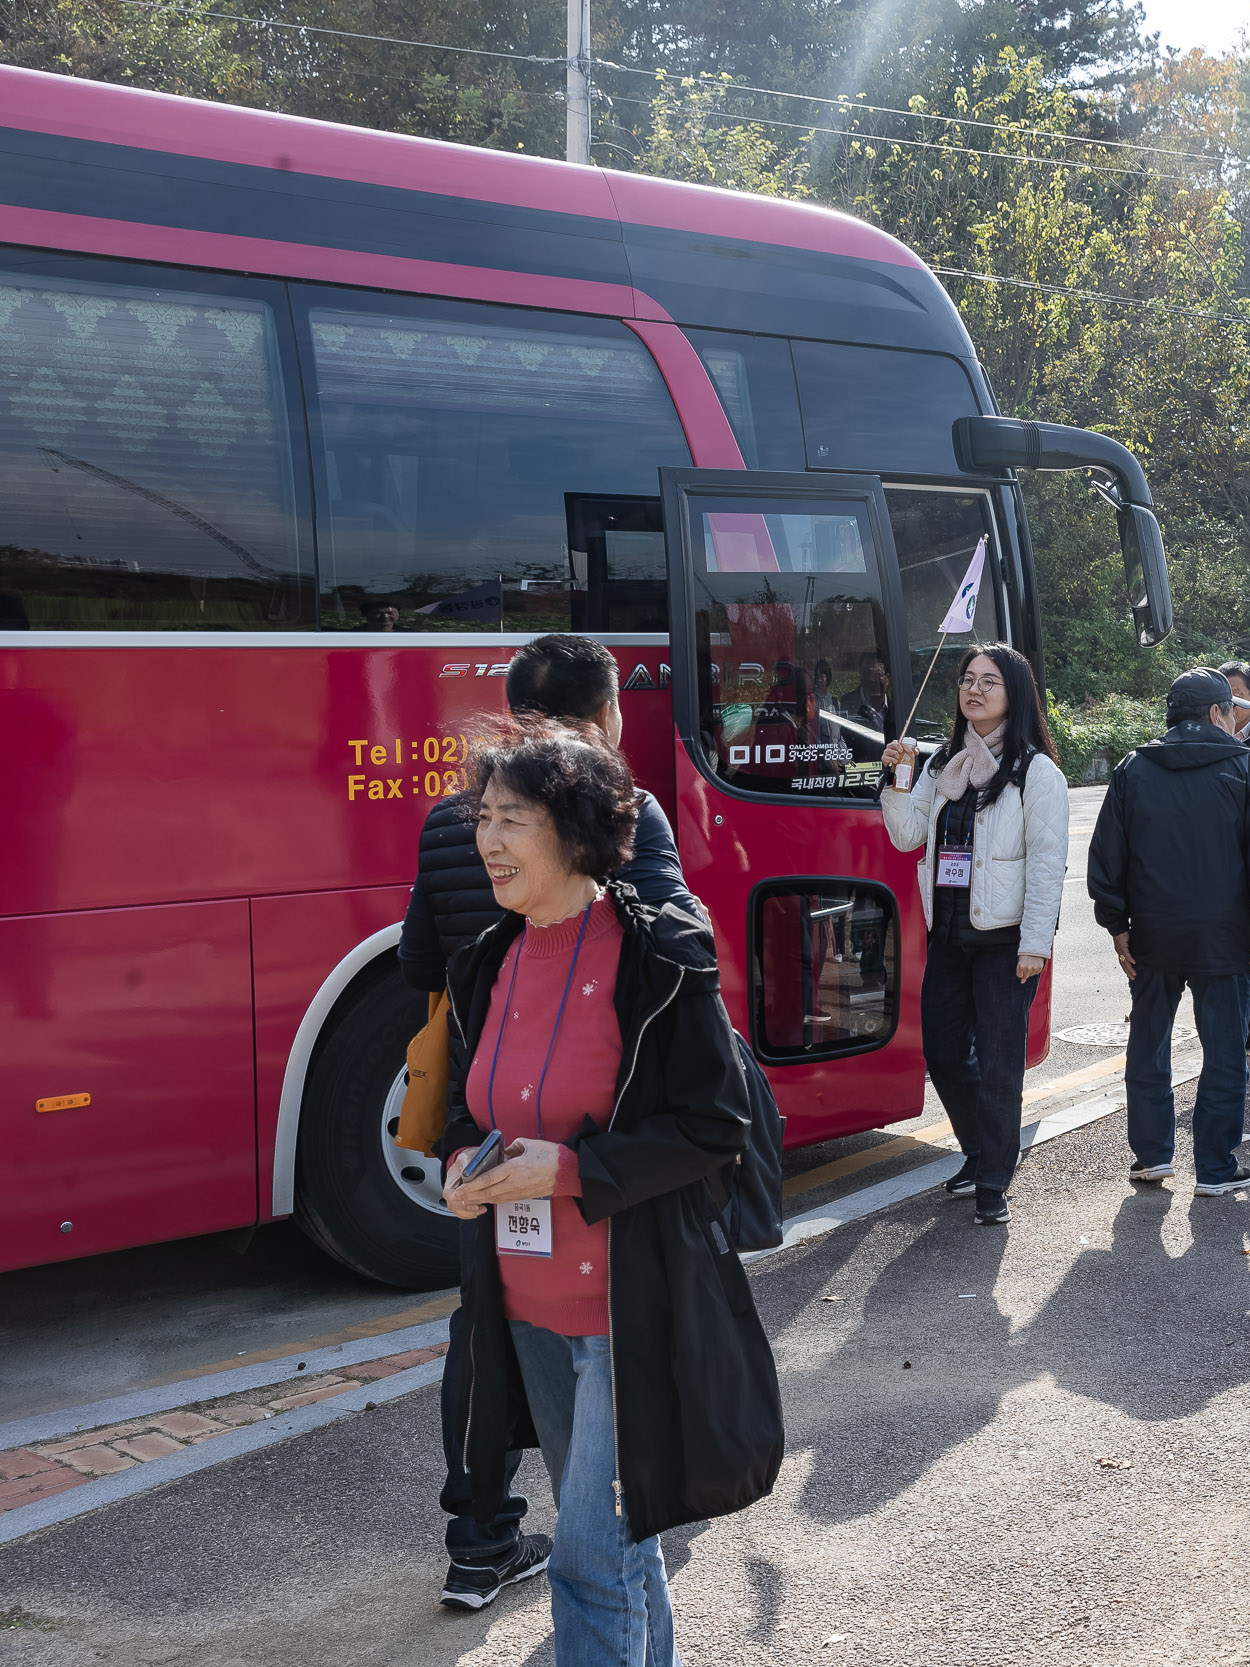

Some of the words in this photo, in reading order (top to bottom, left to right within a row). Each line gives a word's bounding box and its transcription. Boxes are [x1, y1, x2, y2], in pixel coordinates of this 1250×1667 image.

[729, 744, 785, 765] 010
[791, 776, 837, 791] 국내최장
[508, 1215, 541, 1236] 전향숙
